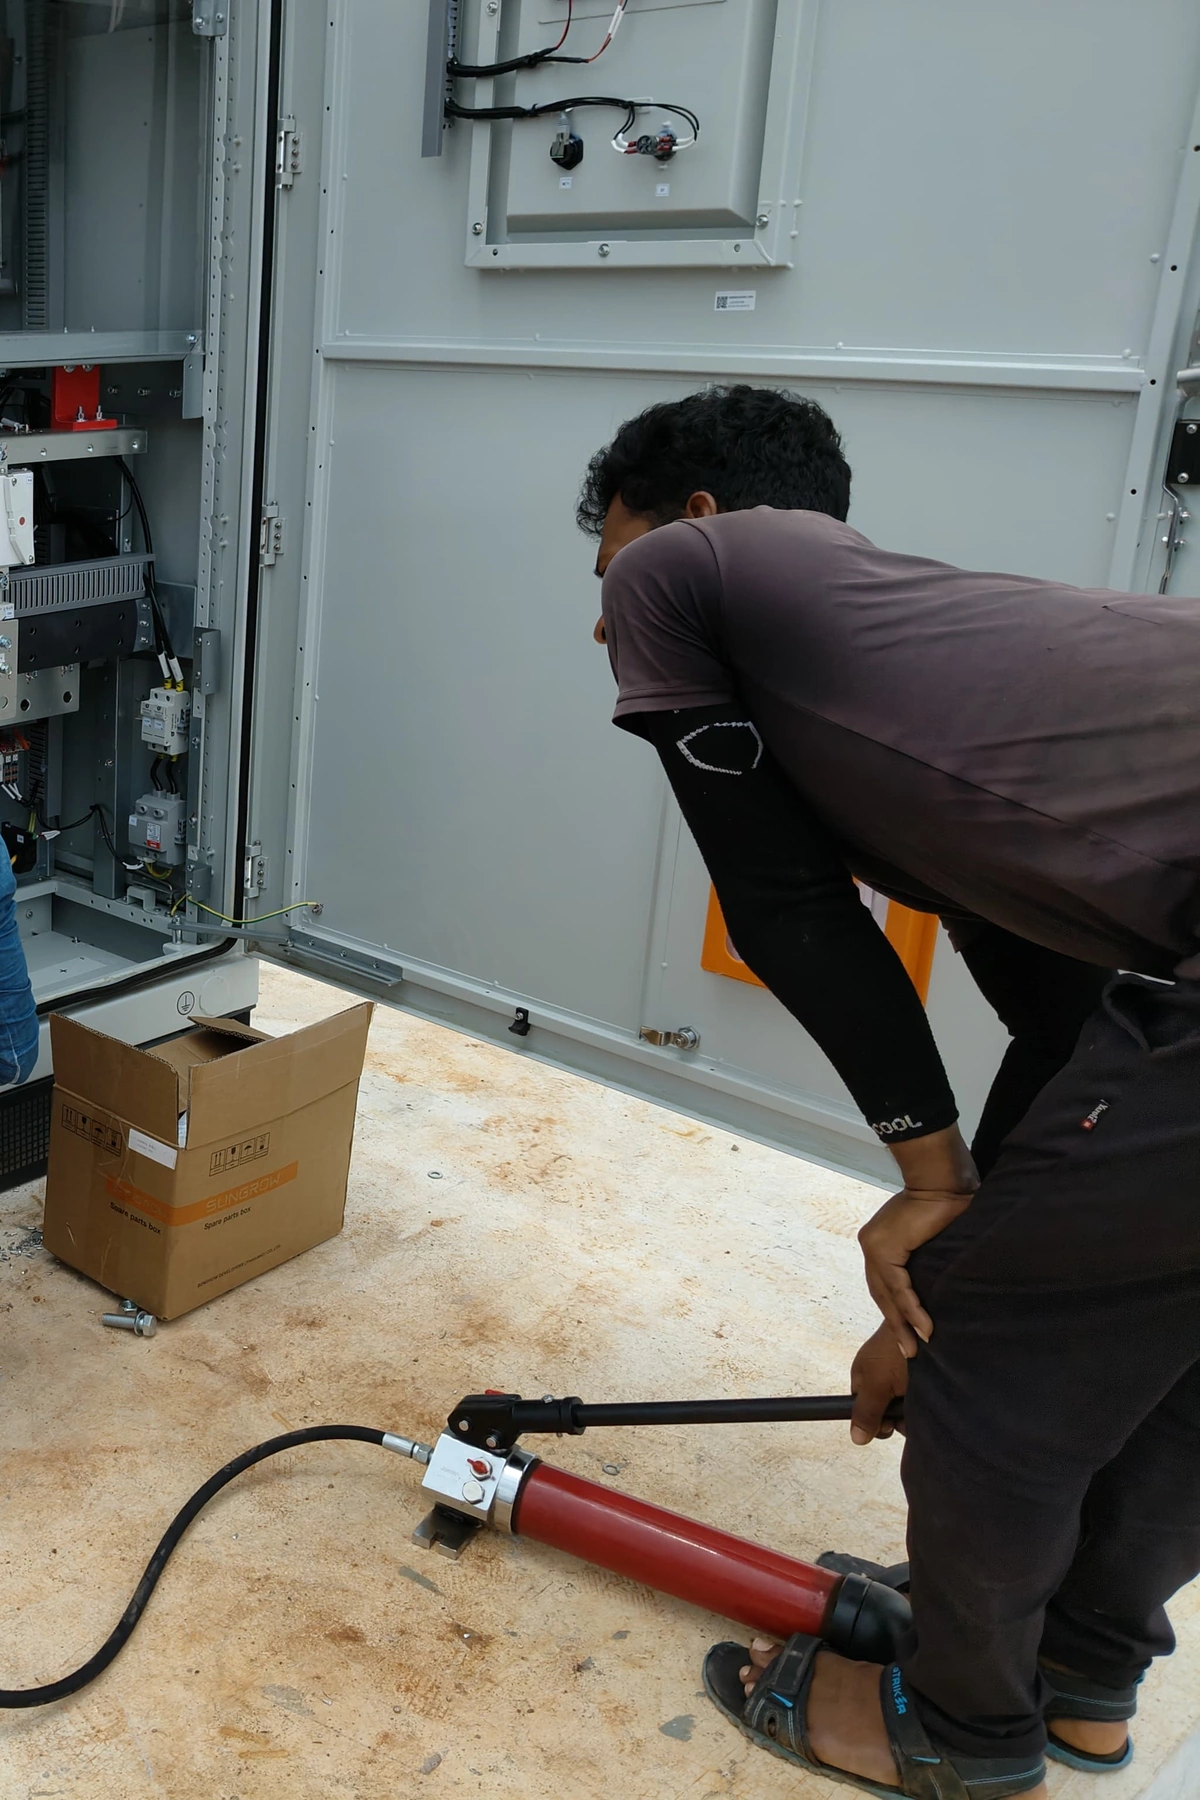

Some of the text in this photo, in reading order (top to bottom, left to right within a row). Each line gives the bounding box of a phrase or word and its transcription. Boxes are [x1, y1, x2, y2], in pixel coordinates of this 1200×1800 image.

[871, 1113, 923, 1136] COOL
[206, 1171, 281, 1213] SUNGROW
[109, 1201, 129, 1218] Spare
[129, 1213, 148, 1229] parts
[148, 1222, 162, 1235] box
[203, 1205, 252, 1231] Spare parts box
